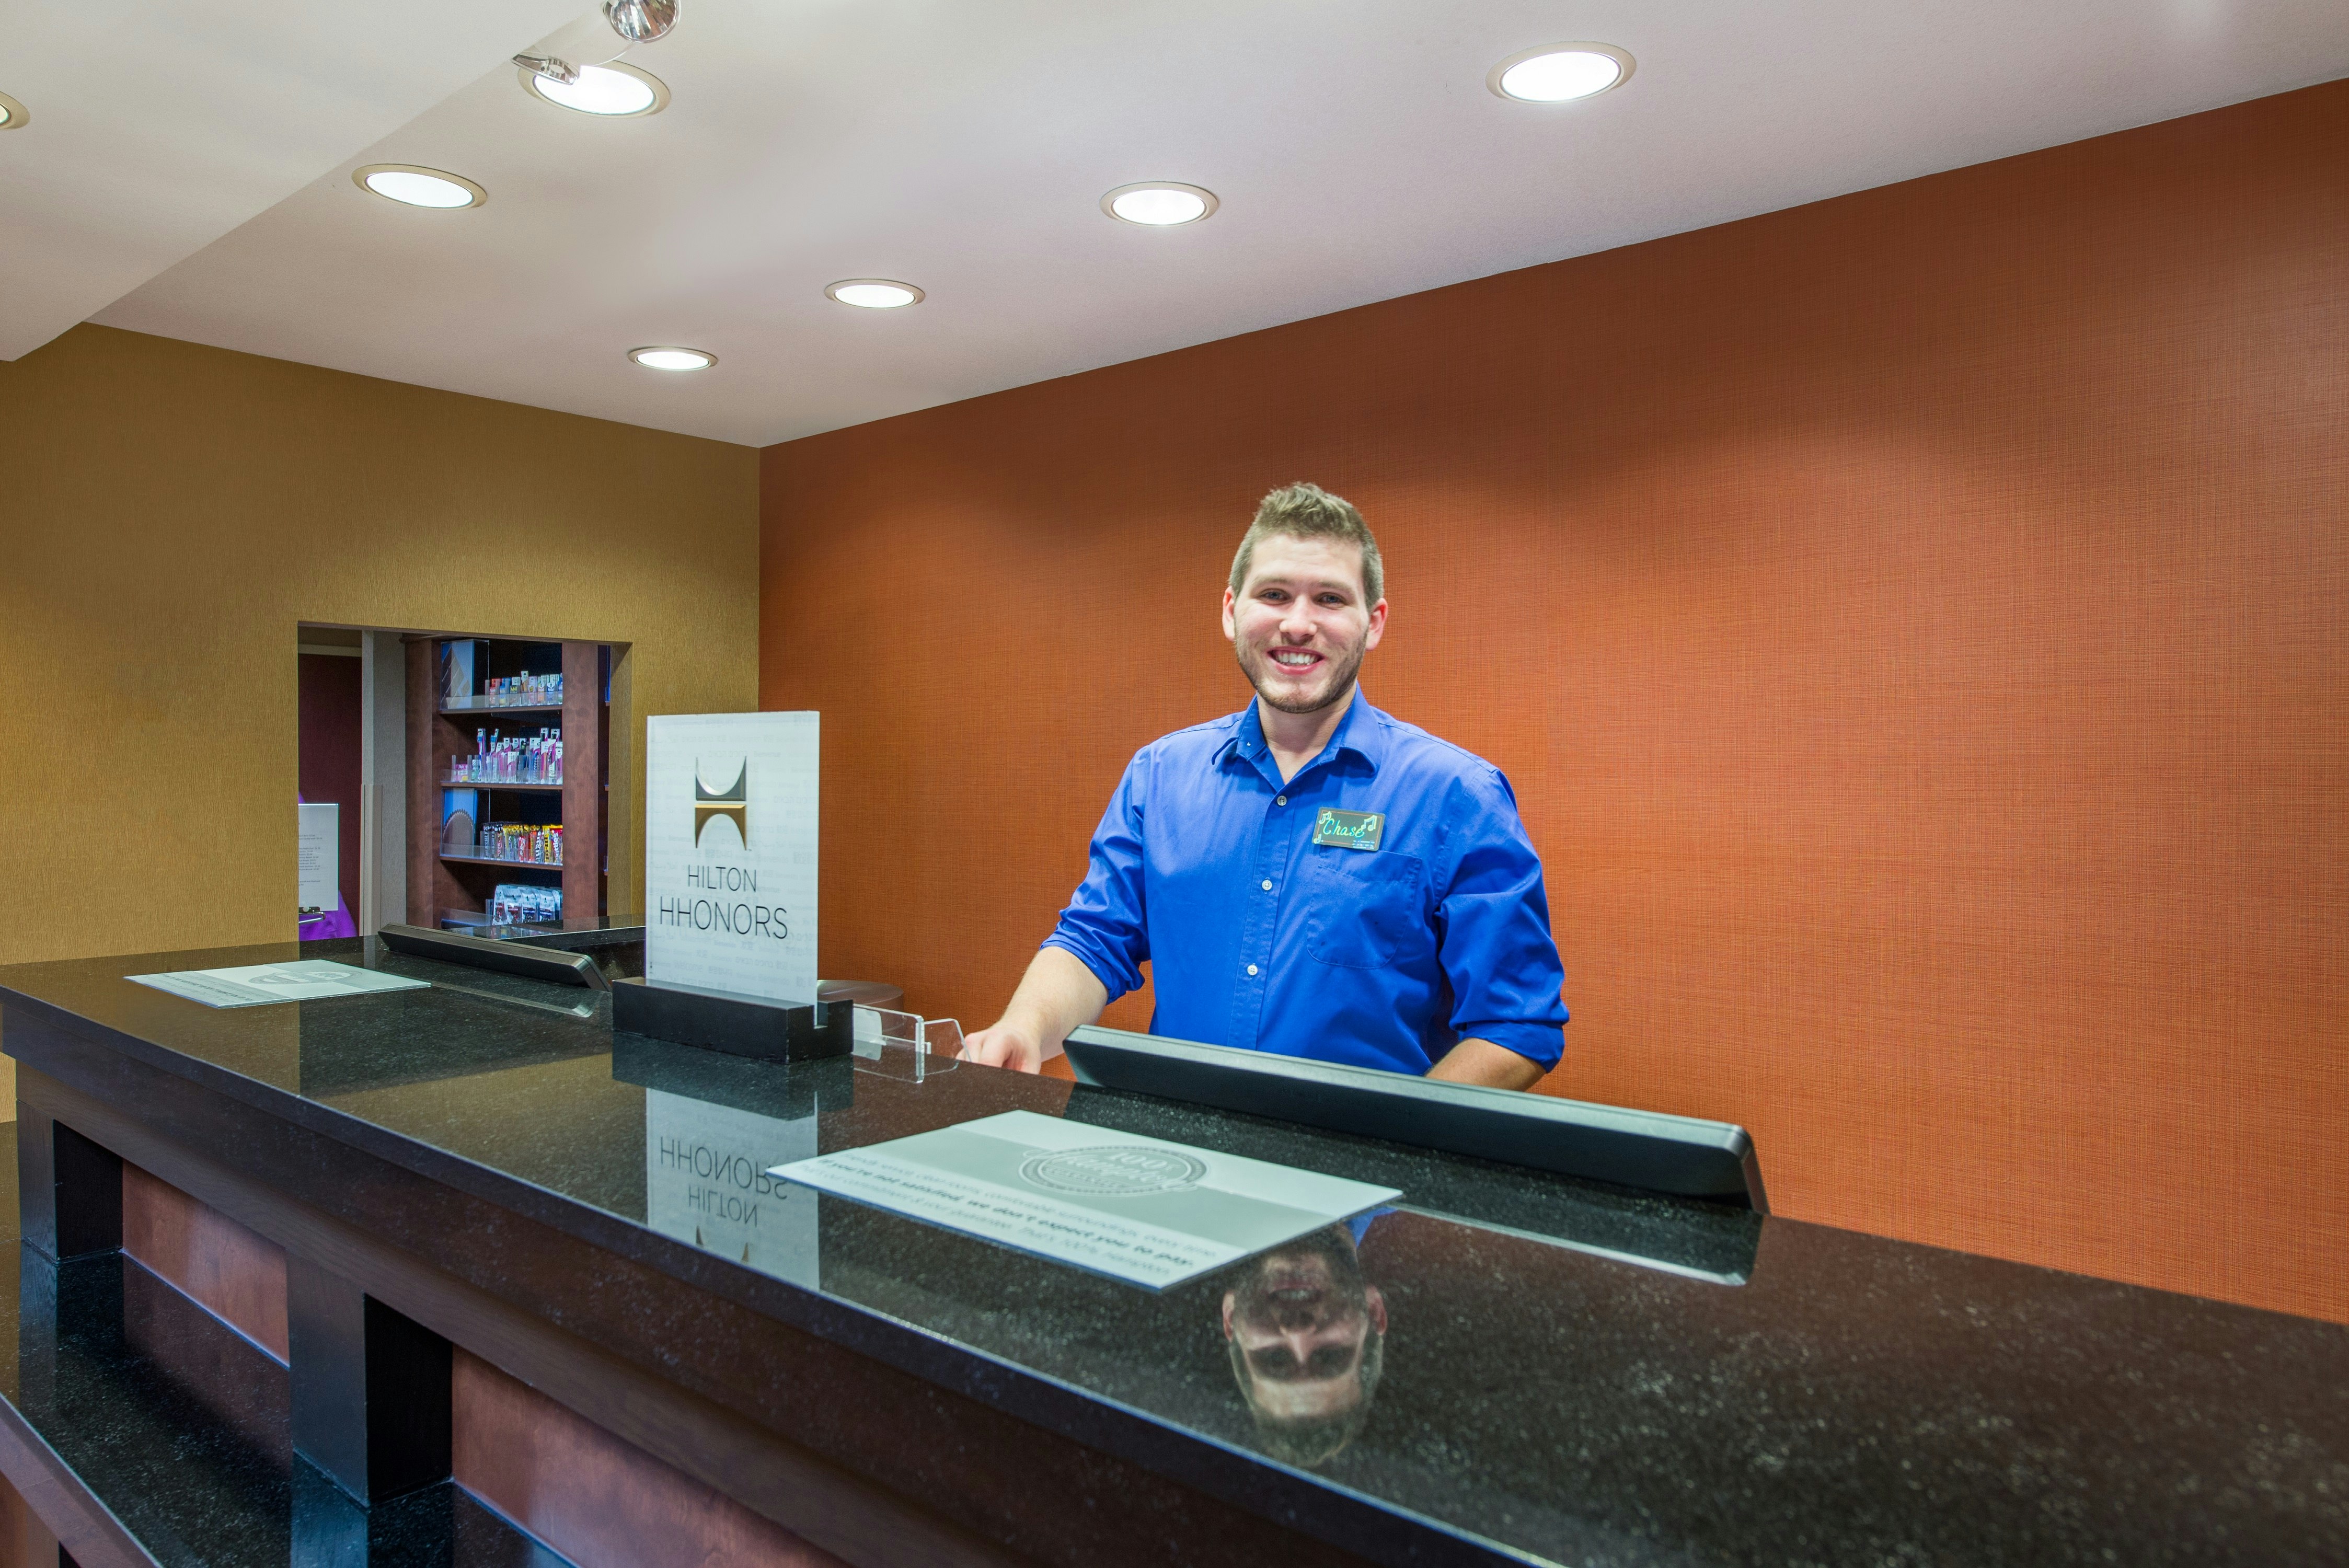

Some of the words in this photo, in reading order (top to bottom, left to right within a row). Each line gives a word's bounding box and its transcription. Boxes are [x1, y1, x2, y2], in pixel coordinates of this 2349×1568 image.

[1323, 818, 1365, 838] Chase
[688, 865, 757, 892] HILTON
[660, 896, 788, 940] HHONORS
